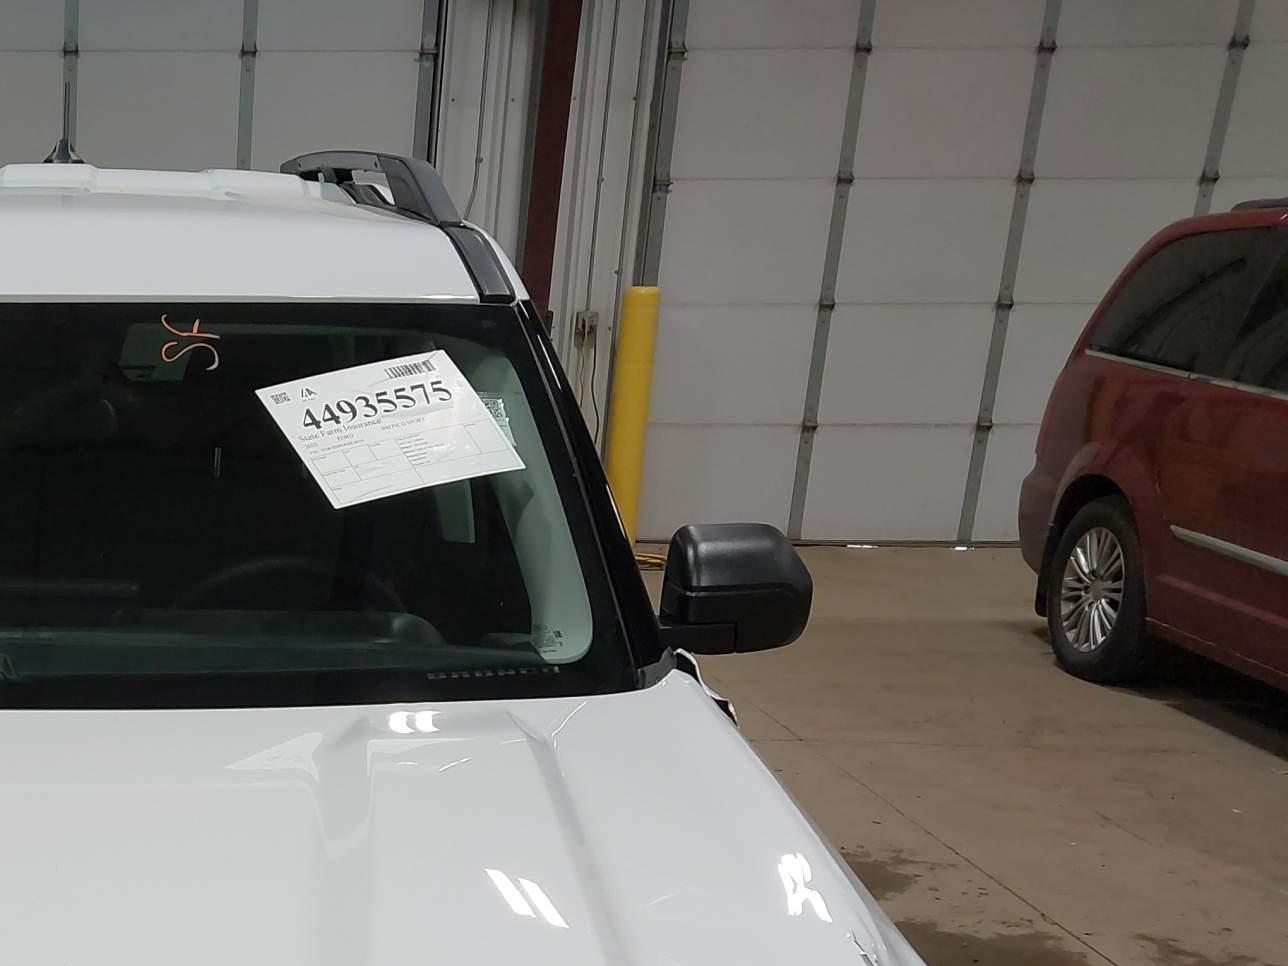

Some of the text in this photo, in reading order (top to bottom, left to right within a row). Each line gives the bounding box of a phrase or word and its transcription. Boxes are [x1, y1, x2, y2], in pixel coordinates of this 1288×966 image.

[303, 381, 452, 430] 44935575
[298, 417, 382, 442] State Farm Insurance
